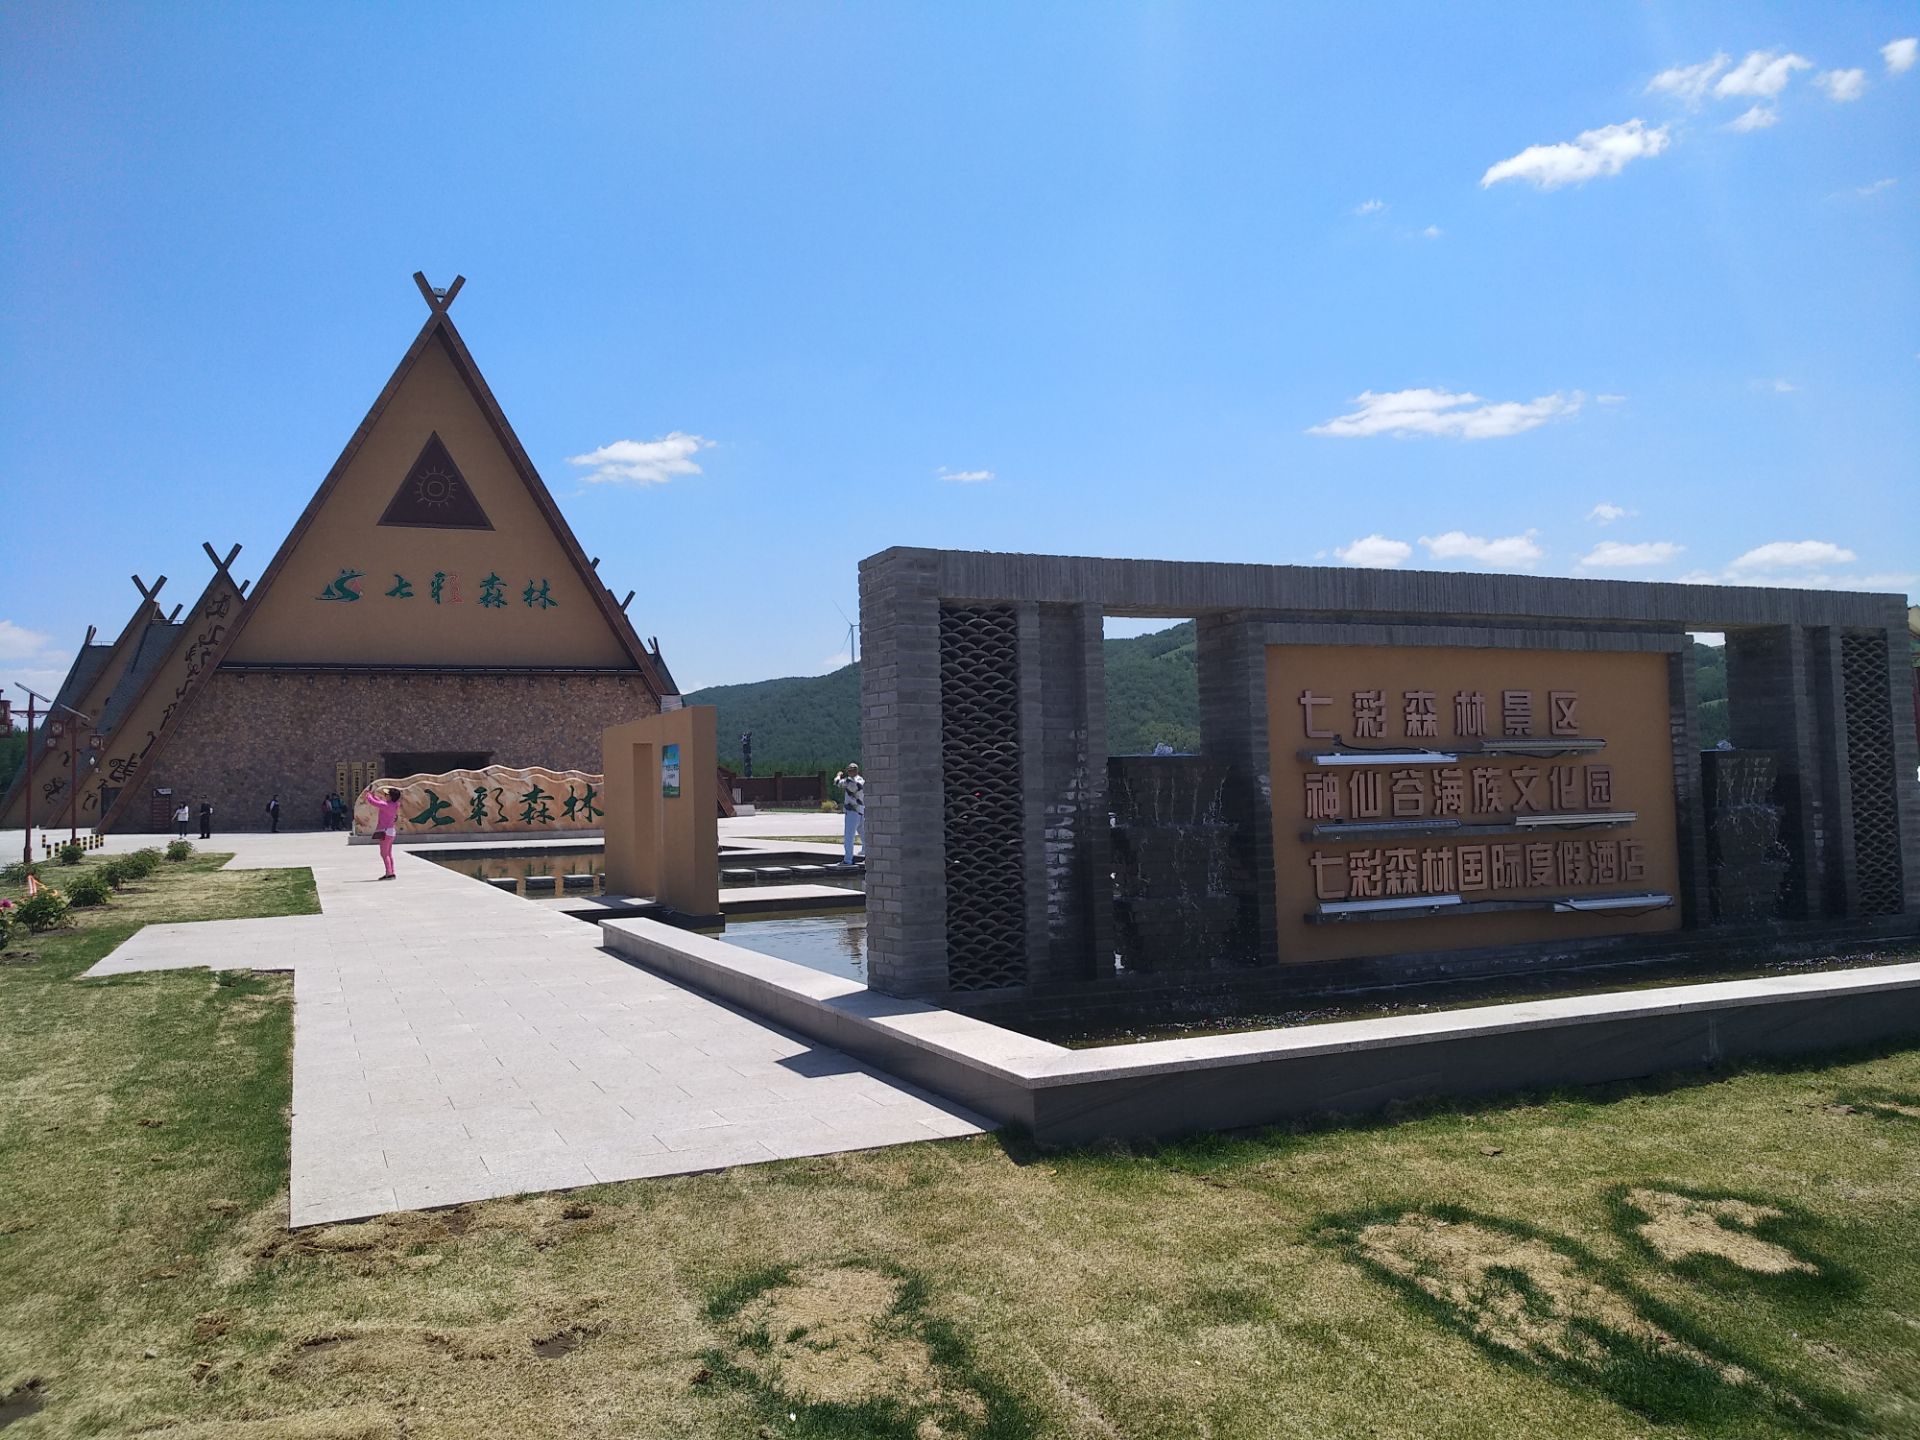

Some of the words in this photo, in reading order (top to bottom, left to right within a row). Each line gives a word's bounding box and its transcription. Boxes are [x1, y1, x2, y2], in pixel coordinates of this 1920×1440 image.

[1299, 689, 1580, 739] 七彩森林景区
[409, 783, 604, 829] 七彩森林
[1305, 764, 1615, 820] 神仙谷满族文化园
[1310, 838, 1647, 899] 七彩森林国际度假酒店
